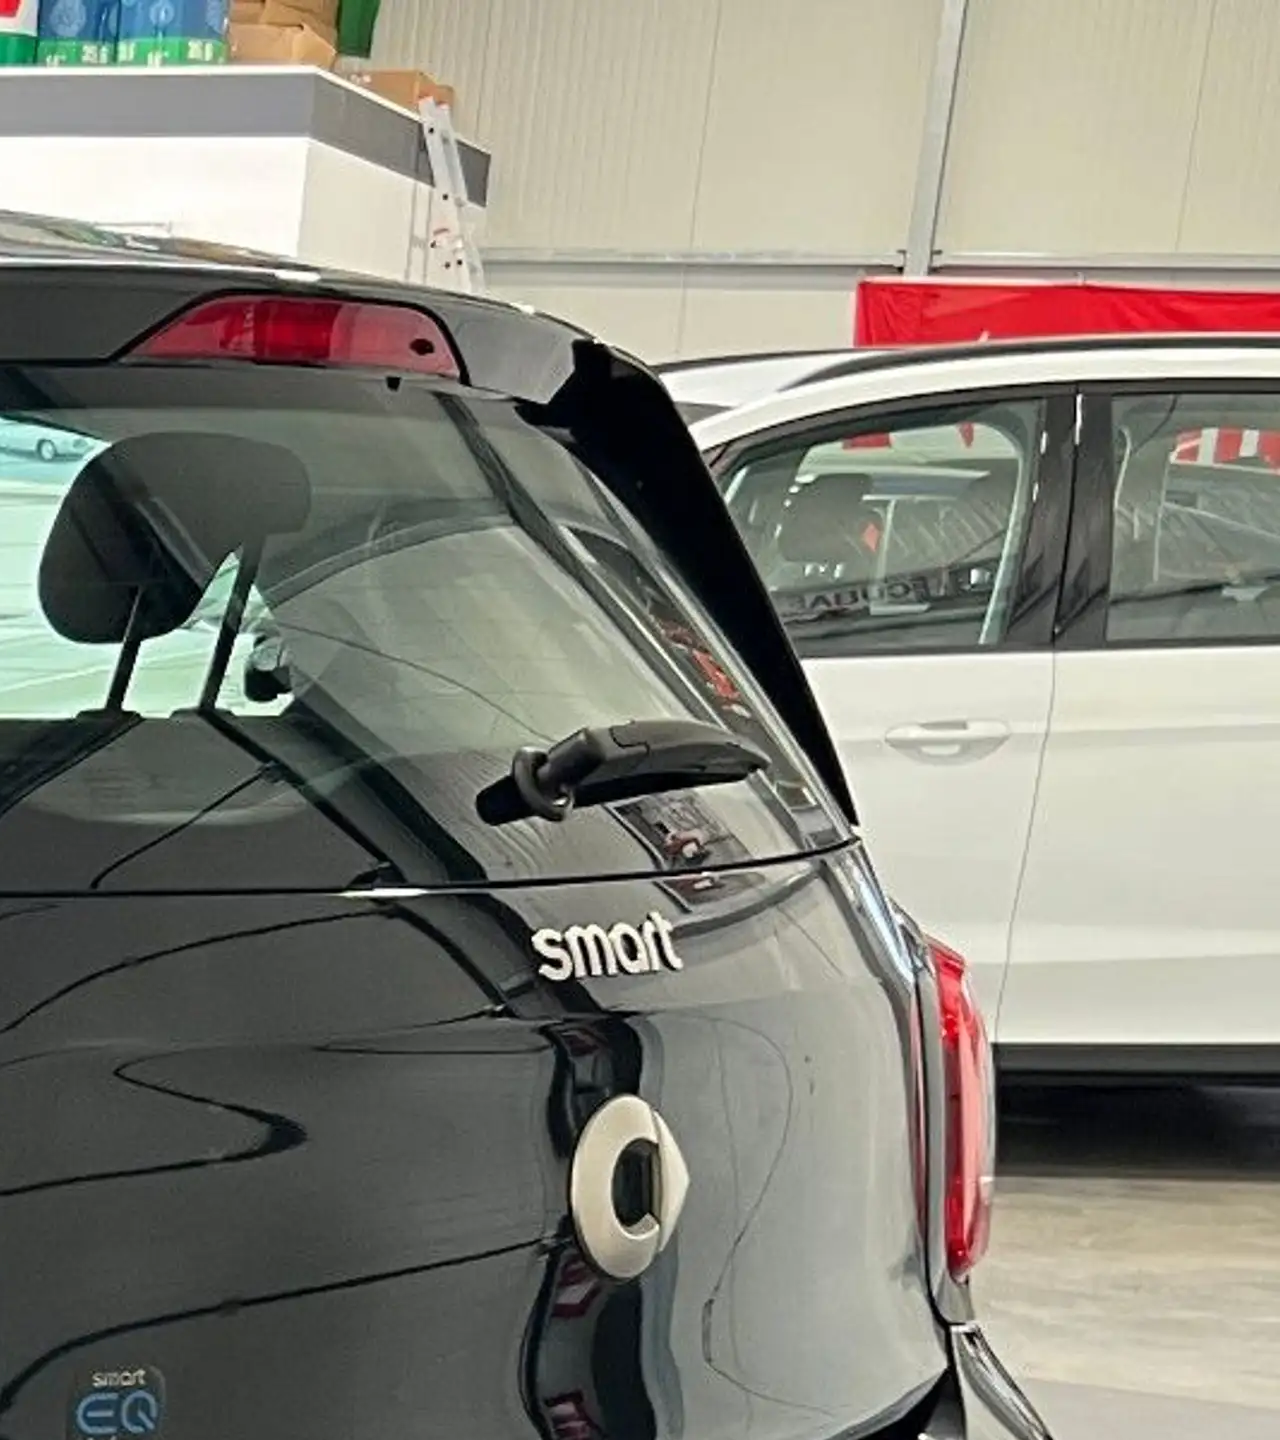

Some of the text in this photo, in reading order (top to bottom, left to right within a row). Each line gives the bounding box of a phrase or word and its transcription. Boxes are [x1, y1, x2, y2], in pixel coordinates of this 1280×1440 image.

[532, 911, 683, 982] smart
[92, 1368, 146, 1388] smart
[77, 1390, 158, 1435] EQ
